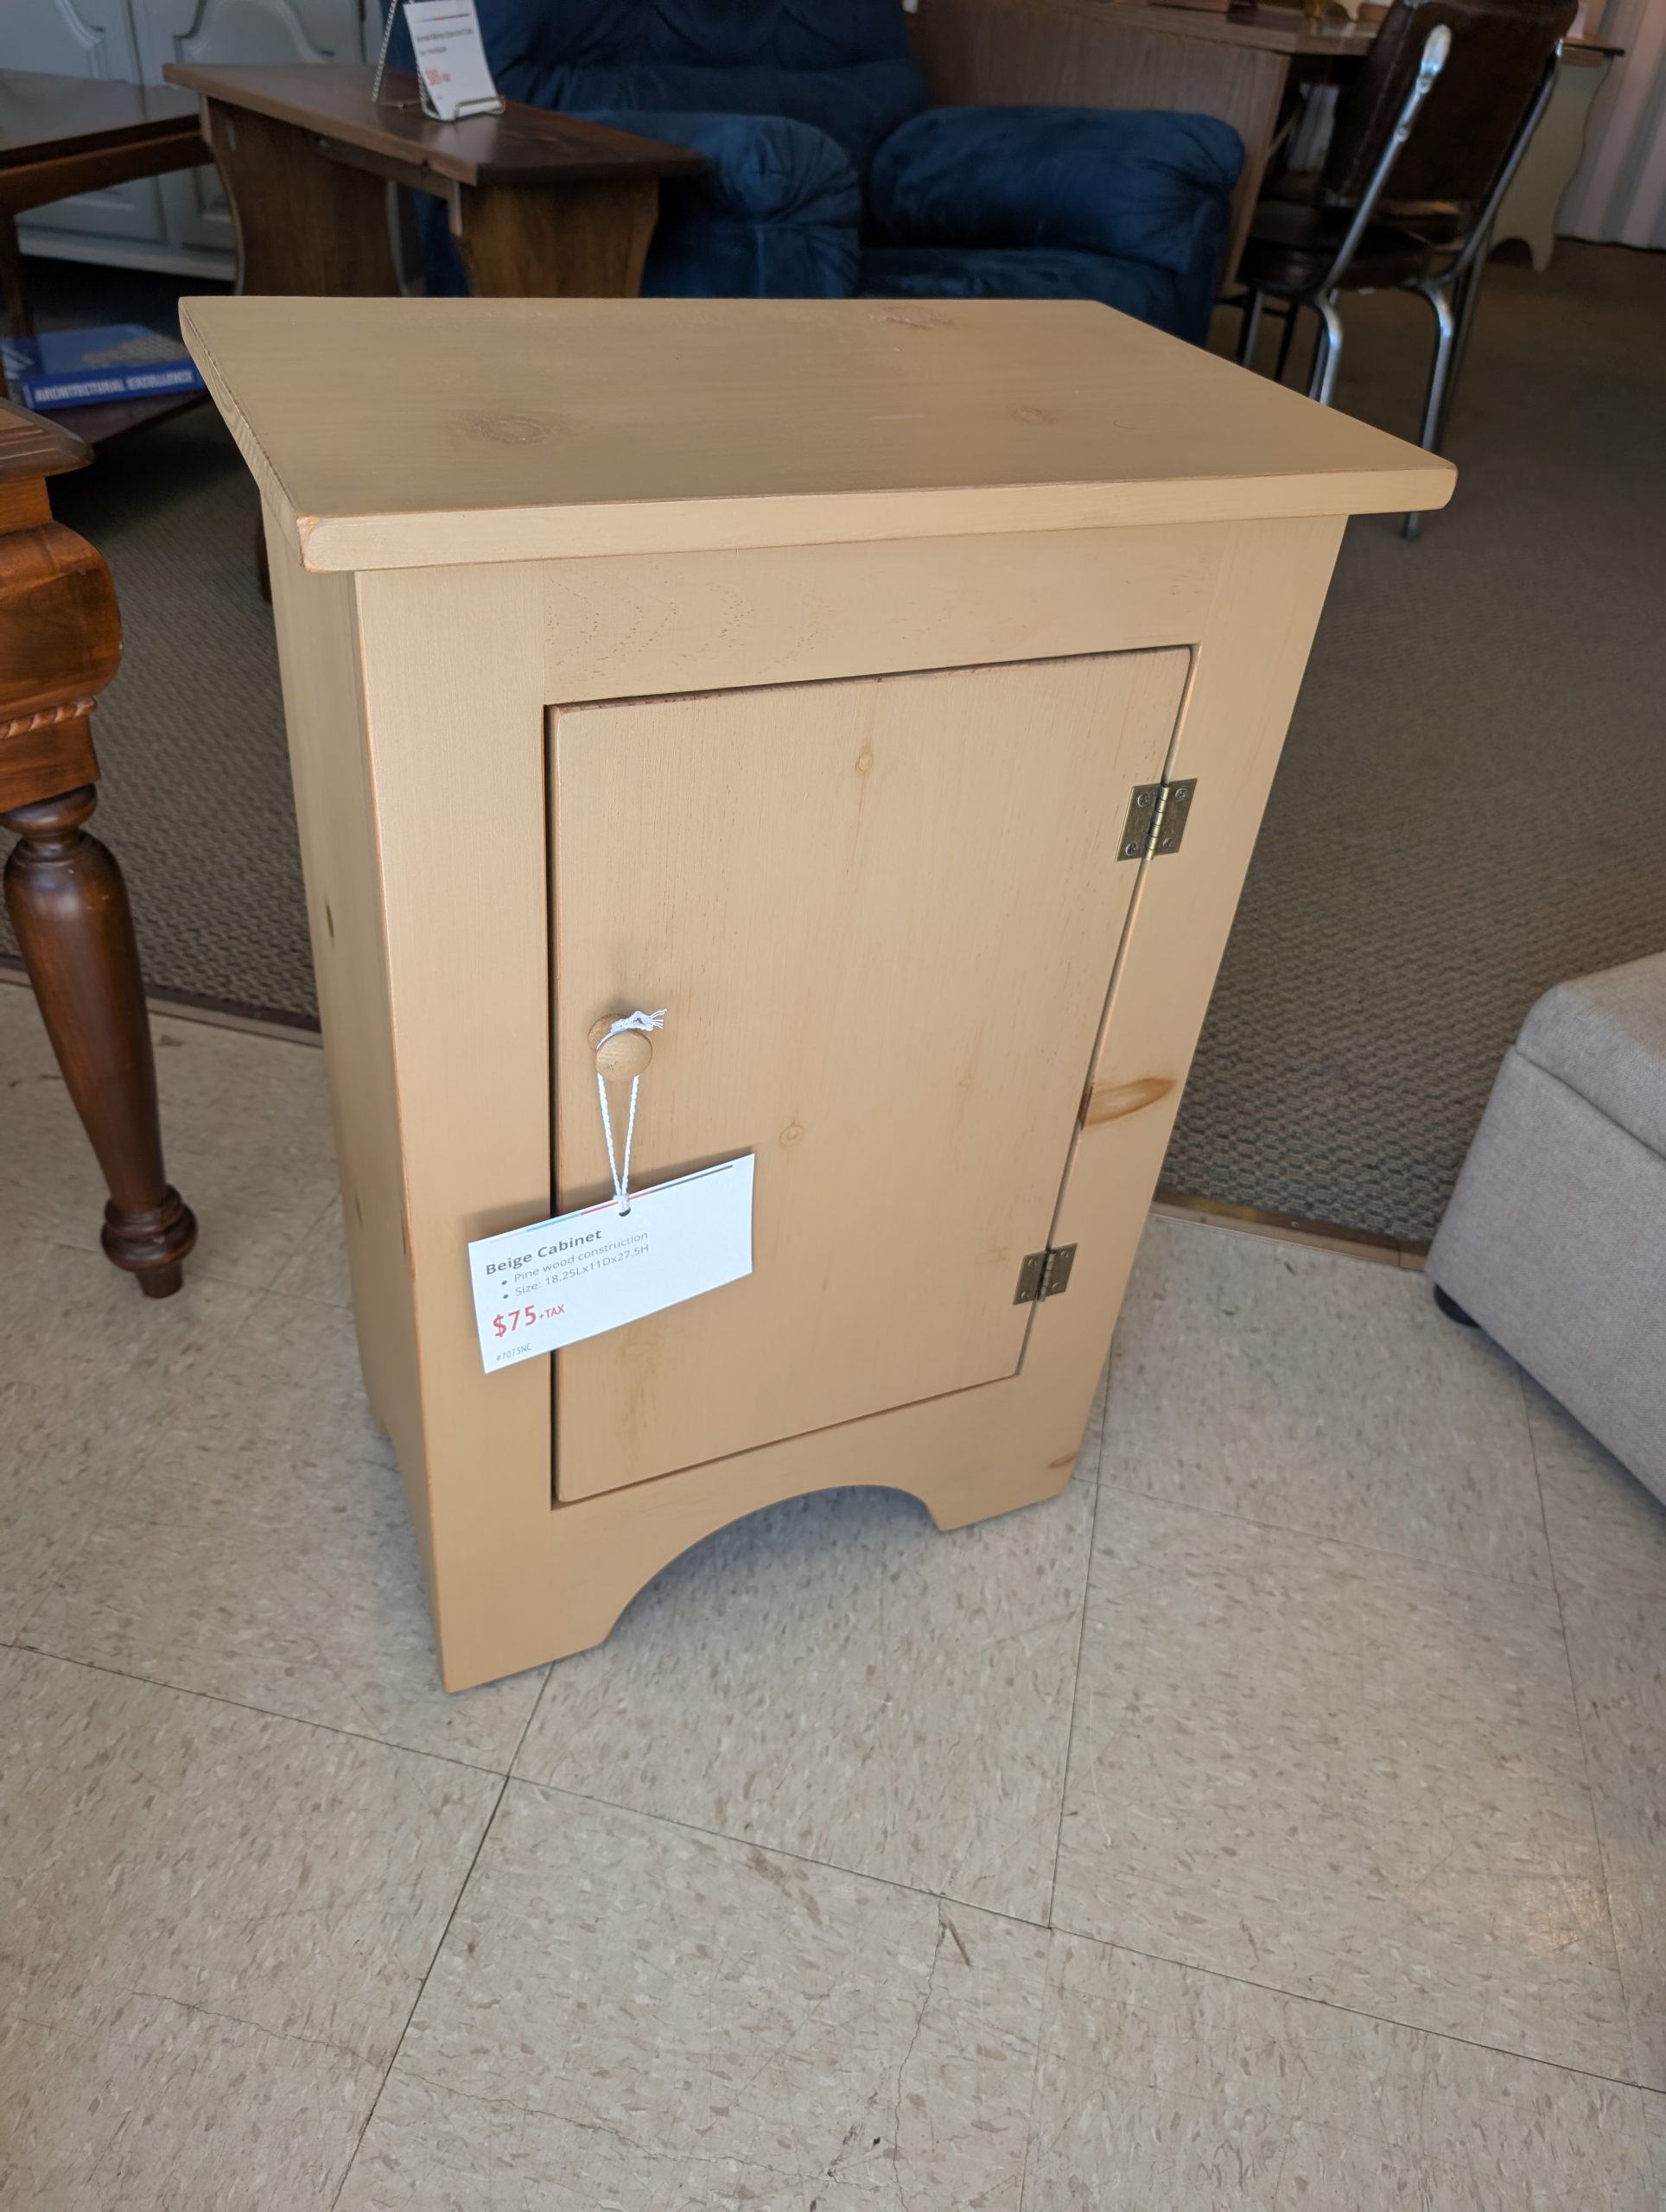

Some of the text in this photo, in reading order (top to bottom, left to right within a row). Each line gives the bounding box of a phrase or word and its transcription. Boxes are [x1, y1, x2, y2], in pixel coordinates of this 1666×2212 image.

[35, 370, 194, 403] ARCHITECTURAL EXCELLENCE
[486, 1230, 602, 1275] Beige Cabinet
[513, 1231, 648, 1283] Pine wood construction
[515, 1281, 542, 1297] Size:
